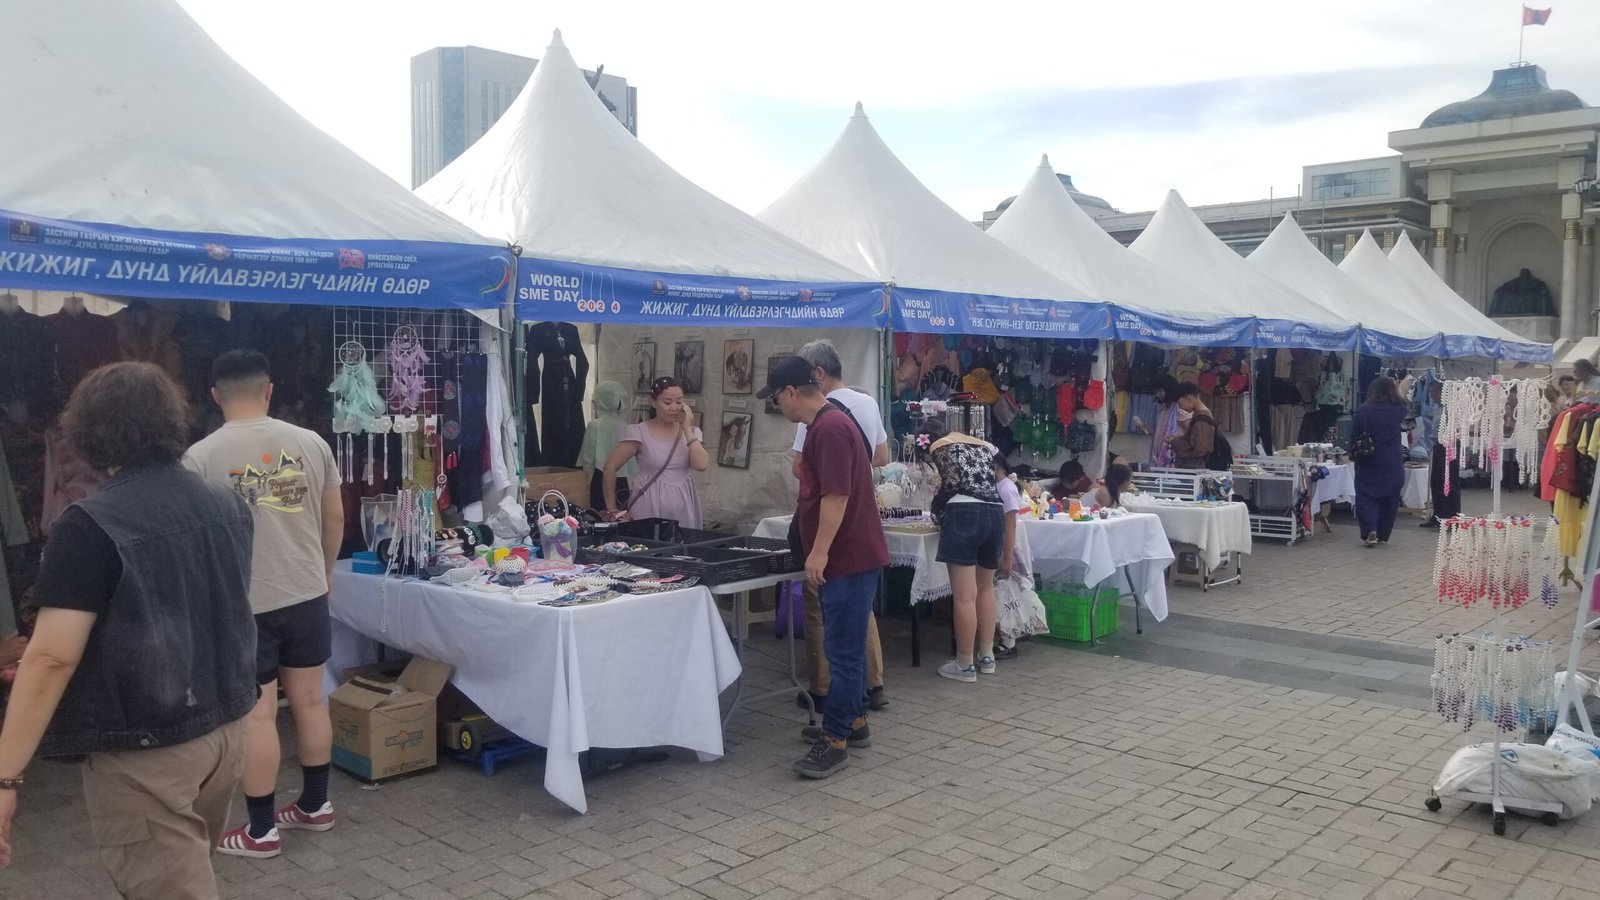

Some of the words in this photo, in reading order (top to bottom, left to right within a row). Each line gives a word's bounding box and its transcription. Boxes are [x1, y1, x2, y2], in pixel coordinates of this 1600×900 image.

[106, 260, 170, 282] ДУНД
[178, 263, 378, 293] ҮЙЛДВЭРЛЭГЧДИЙН
[382, 277, 430, 295] ӨДӨР
[530, 273, 580, 288] WORLD
[519, 287, 550, 301] SME
[554, 289, 580, 302] DAY
[692, 303, 721, 318] ДУНД
[724, 303, 818, 319] ҮЙЛДВЭРЛЭГЧДИЙН
[820, 307, 845, 318] ӨДӨР
[905, 298, 930, 309] WORLD
[901, 308, 916, 318] SME
[917, 310, 931, 319] DAY
